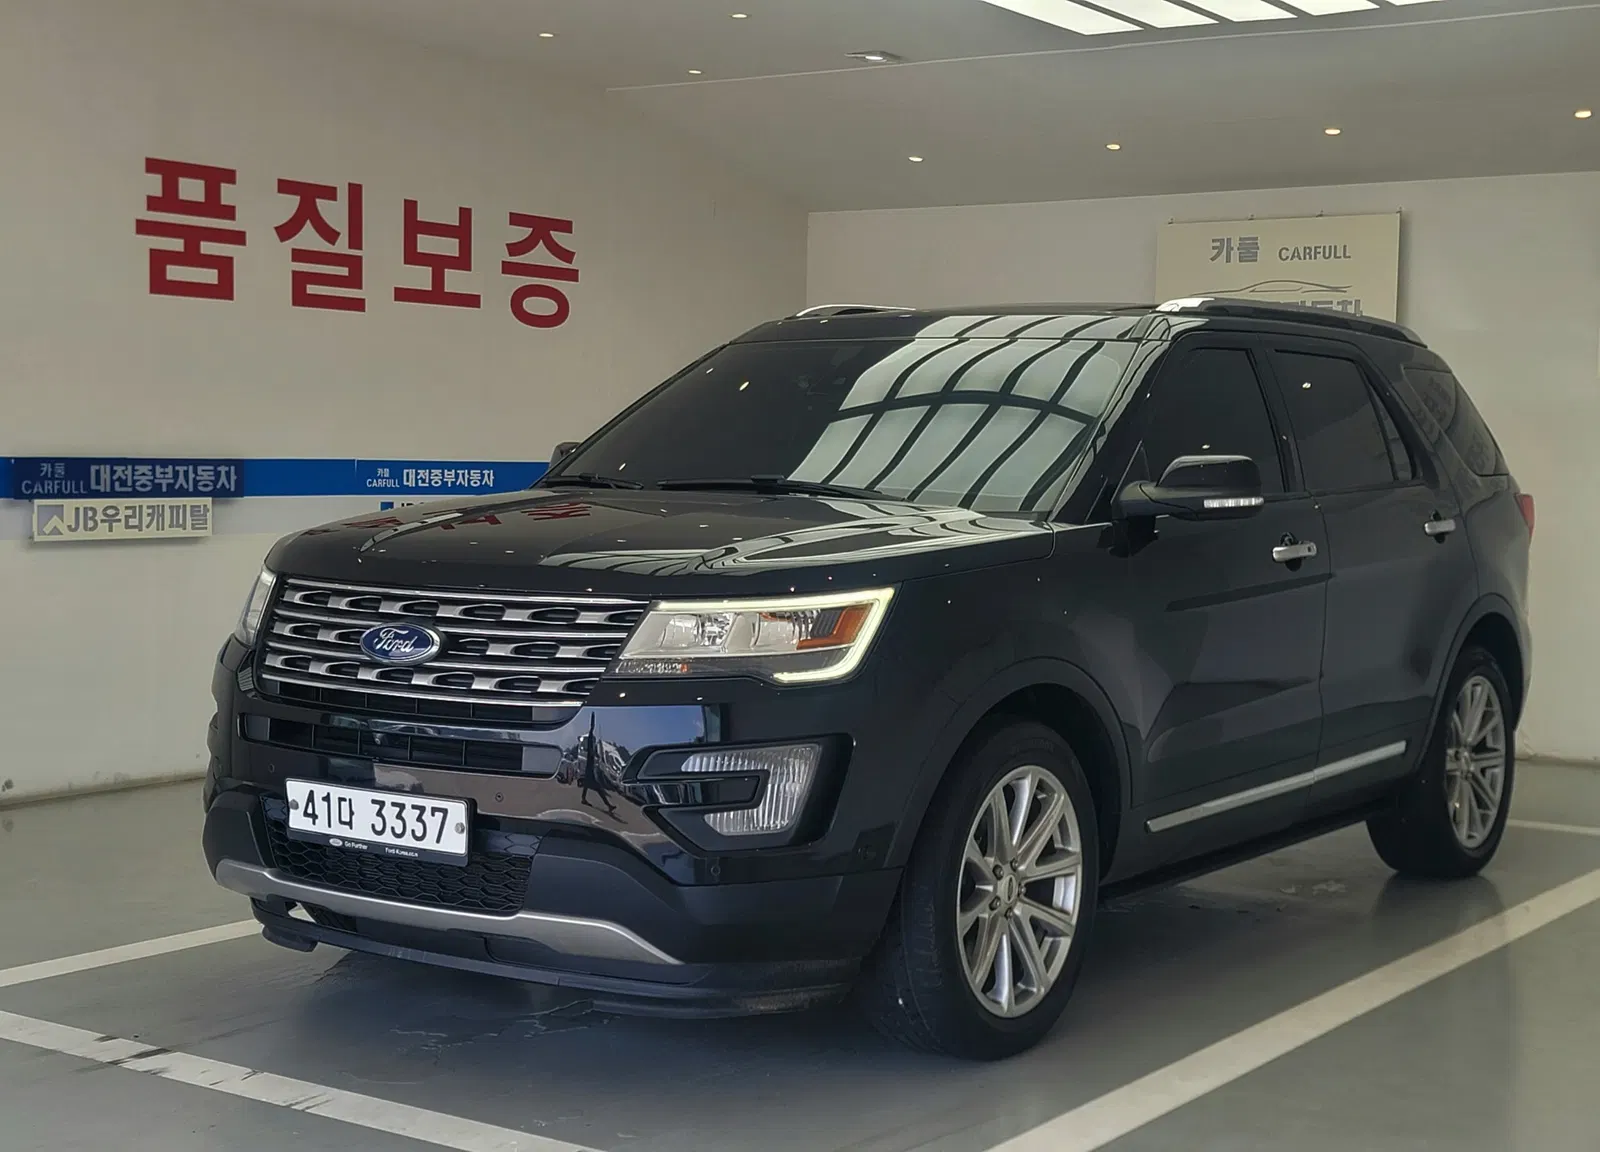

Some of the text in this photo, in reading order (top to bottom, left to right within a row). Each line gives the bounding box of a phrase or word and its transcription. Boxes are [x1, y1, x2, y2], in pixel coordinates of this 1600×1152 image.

[1278, 244, 1352, 262] CARFULL
[21, 480, 87, 494] CARFULL
[90, 464, 237, 493] 대전중부자동차
[366, 478, 400, 488] CARFULL
[402, 468, 494, 488] 대전중부자동차
[66, 503, 210, 533] JB우리캐피탈
[373, 627, 418, 653] Ford
[370, 799, 449, 844] 3337
